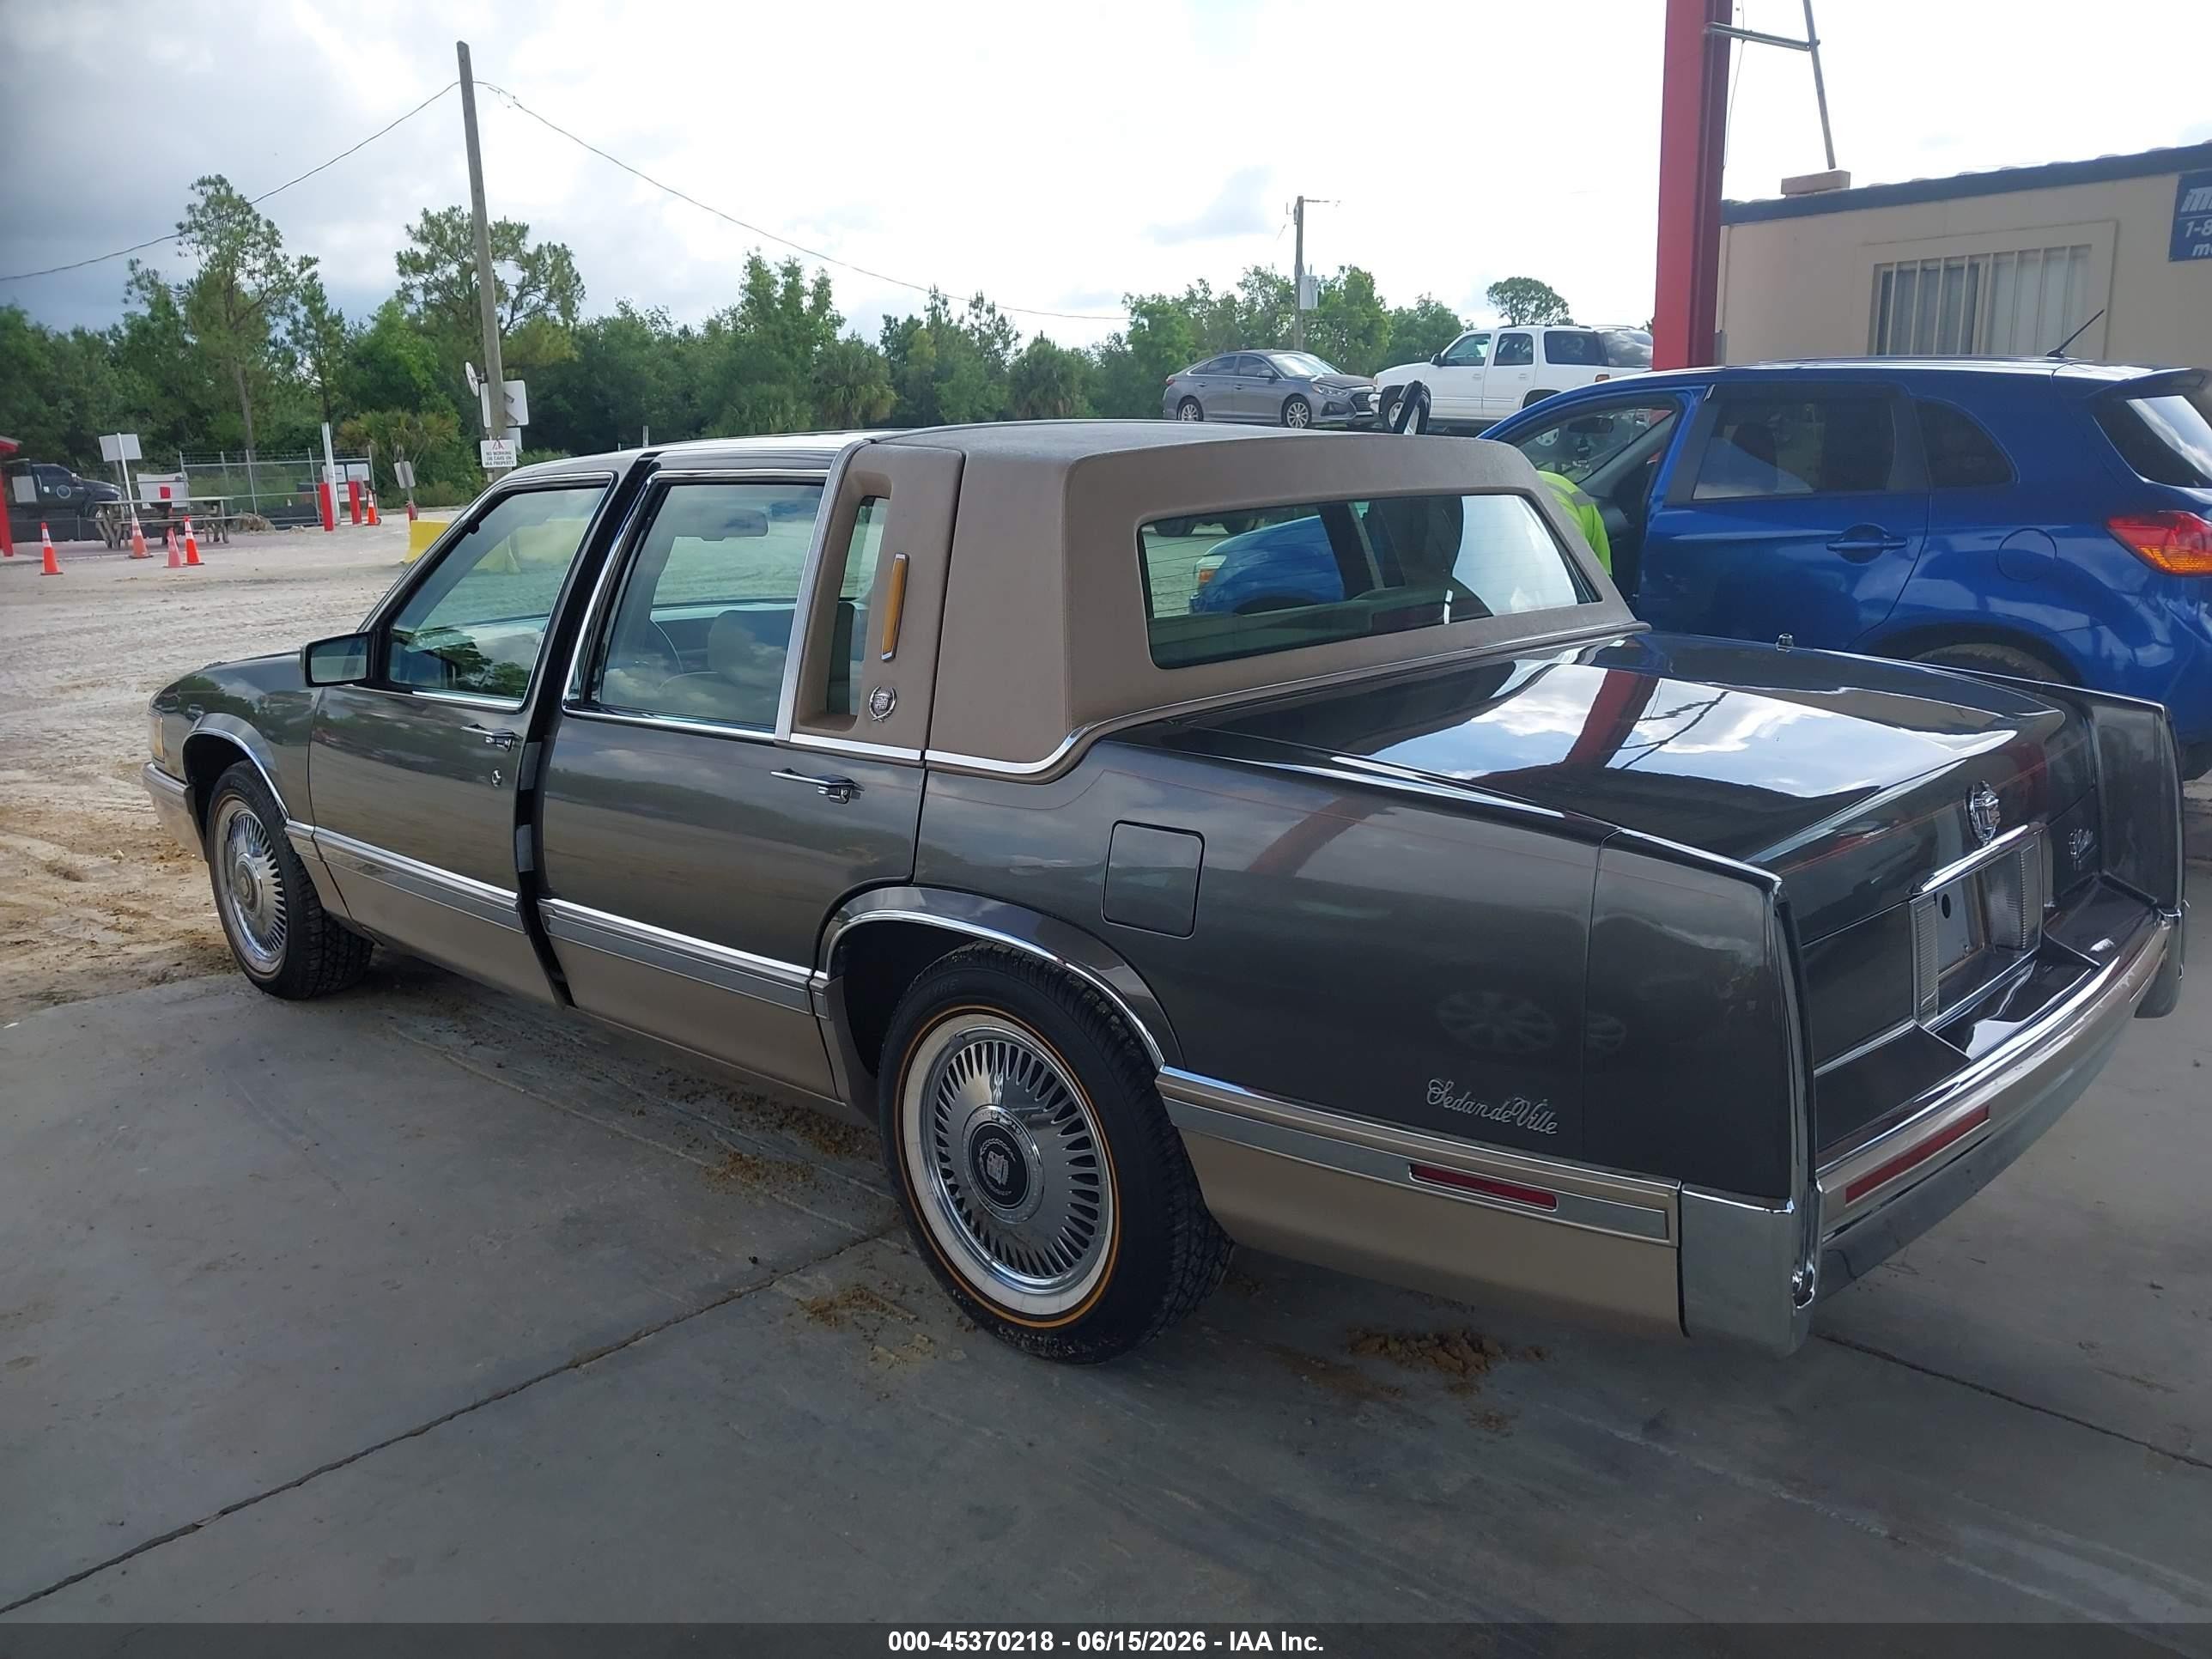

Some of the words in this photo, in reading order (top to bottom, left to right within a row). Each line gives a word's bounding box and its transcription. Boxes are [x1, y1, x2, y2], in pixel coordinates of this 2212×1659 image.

[1426, 1078, 1490, 1117] Sedan
[1489, 1099, 1513, 1123] de
[1513, 1097, 1559, 1135] Ville
